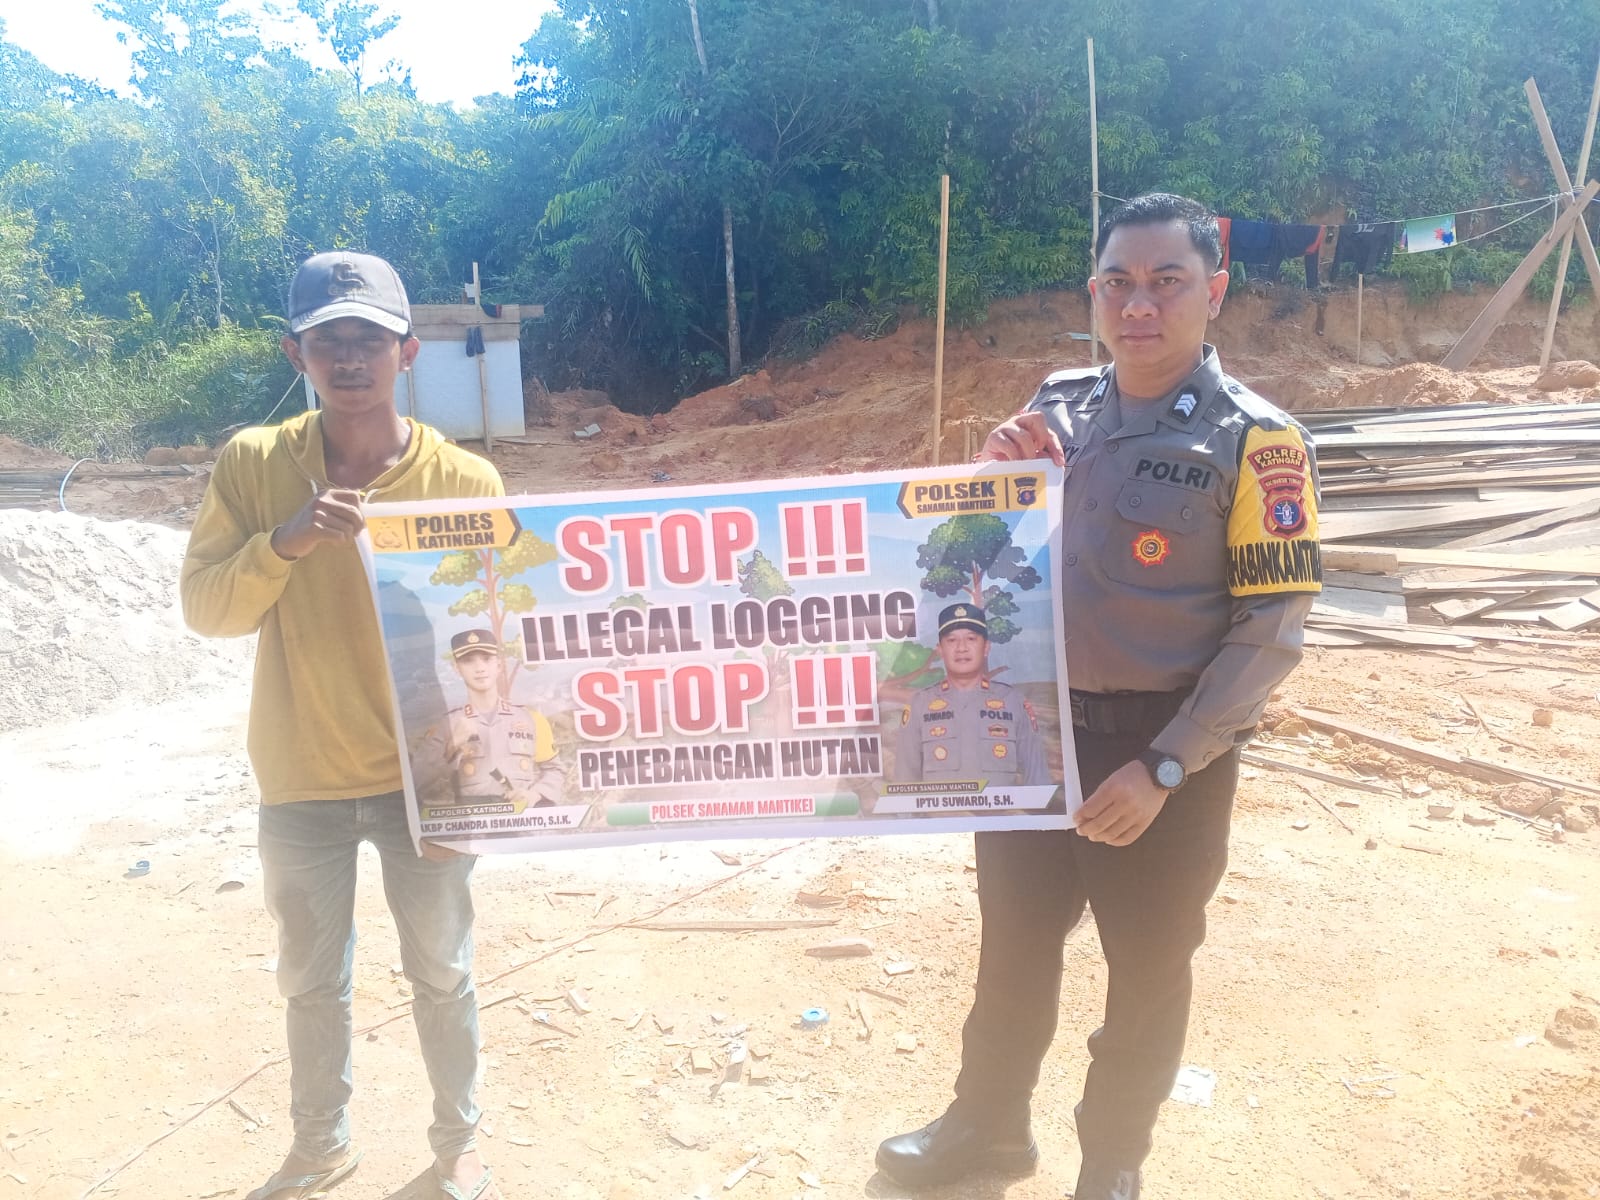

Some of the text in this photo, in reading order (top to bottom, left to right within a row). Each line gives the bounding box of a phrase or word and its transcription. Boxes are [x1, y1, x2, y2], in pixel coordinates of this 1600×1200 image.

[1254, 448, 1303, 464] POLRES
[1135, 459, 1211, 490] POLRI
[914, 481, 997, 502] POLSEK
[415, 512, 494, 534] POLRES
[417, 532, 495, 549] KATINGAN
[560, 502, 866, 593] STOP !!!
[521, 591, 917, 662] ILLEGAL LOGGING
[576, 655, 874, 738] STOP !!!
[980, 710, 1014, 721] POLRI
[580, 737, 881, 789] PENEBANGAN HUTAN
[430, 805, 514, 817] KAPOLRES KATINGAN
[652, 804, 695, 820] POLSEK
[757, 798, 813, 815] MANTIKEI
[916, 795, 1014, 809] IPTU SUWARDI, S.H.
[445, 820, 488, 832] CHANDRA
[548, 814, 572, 826] S.I.K.
